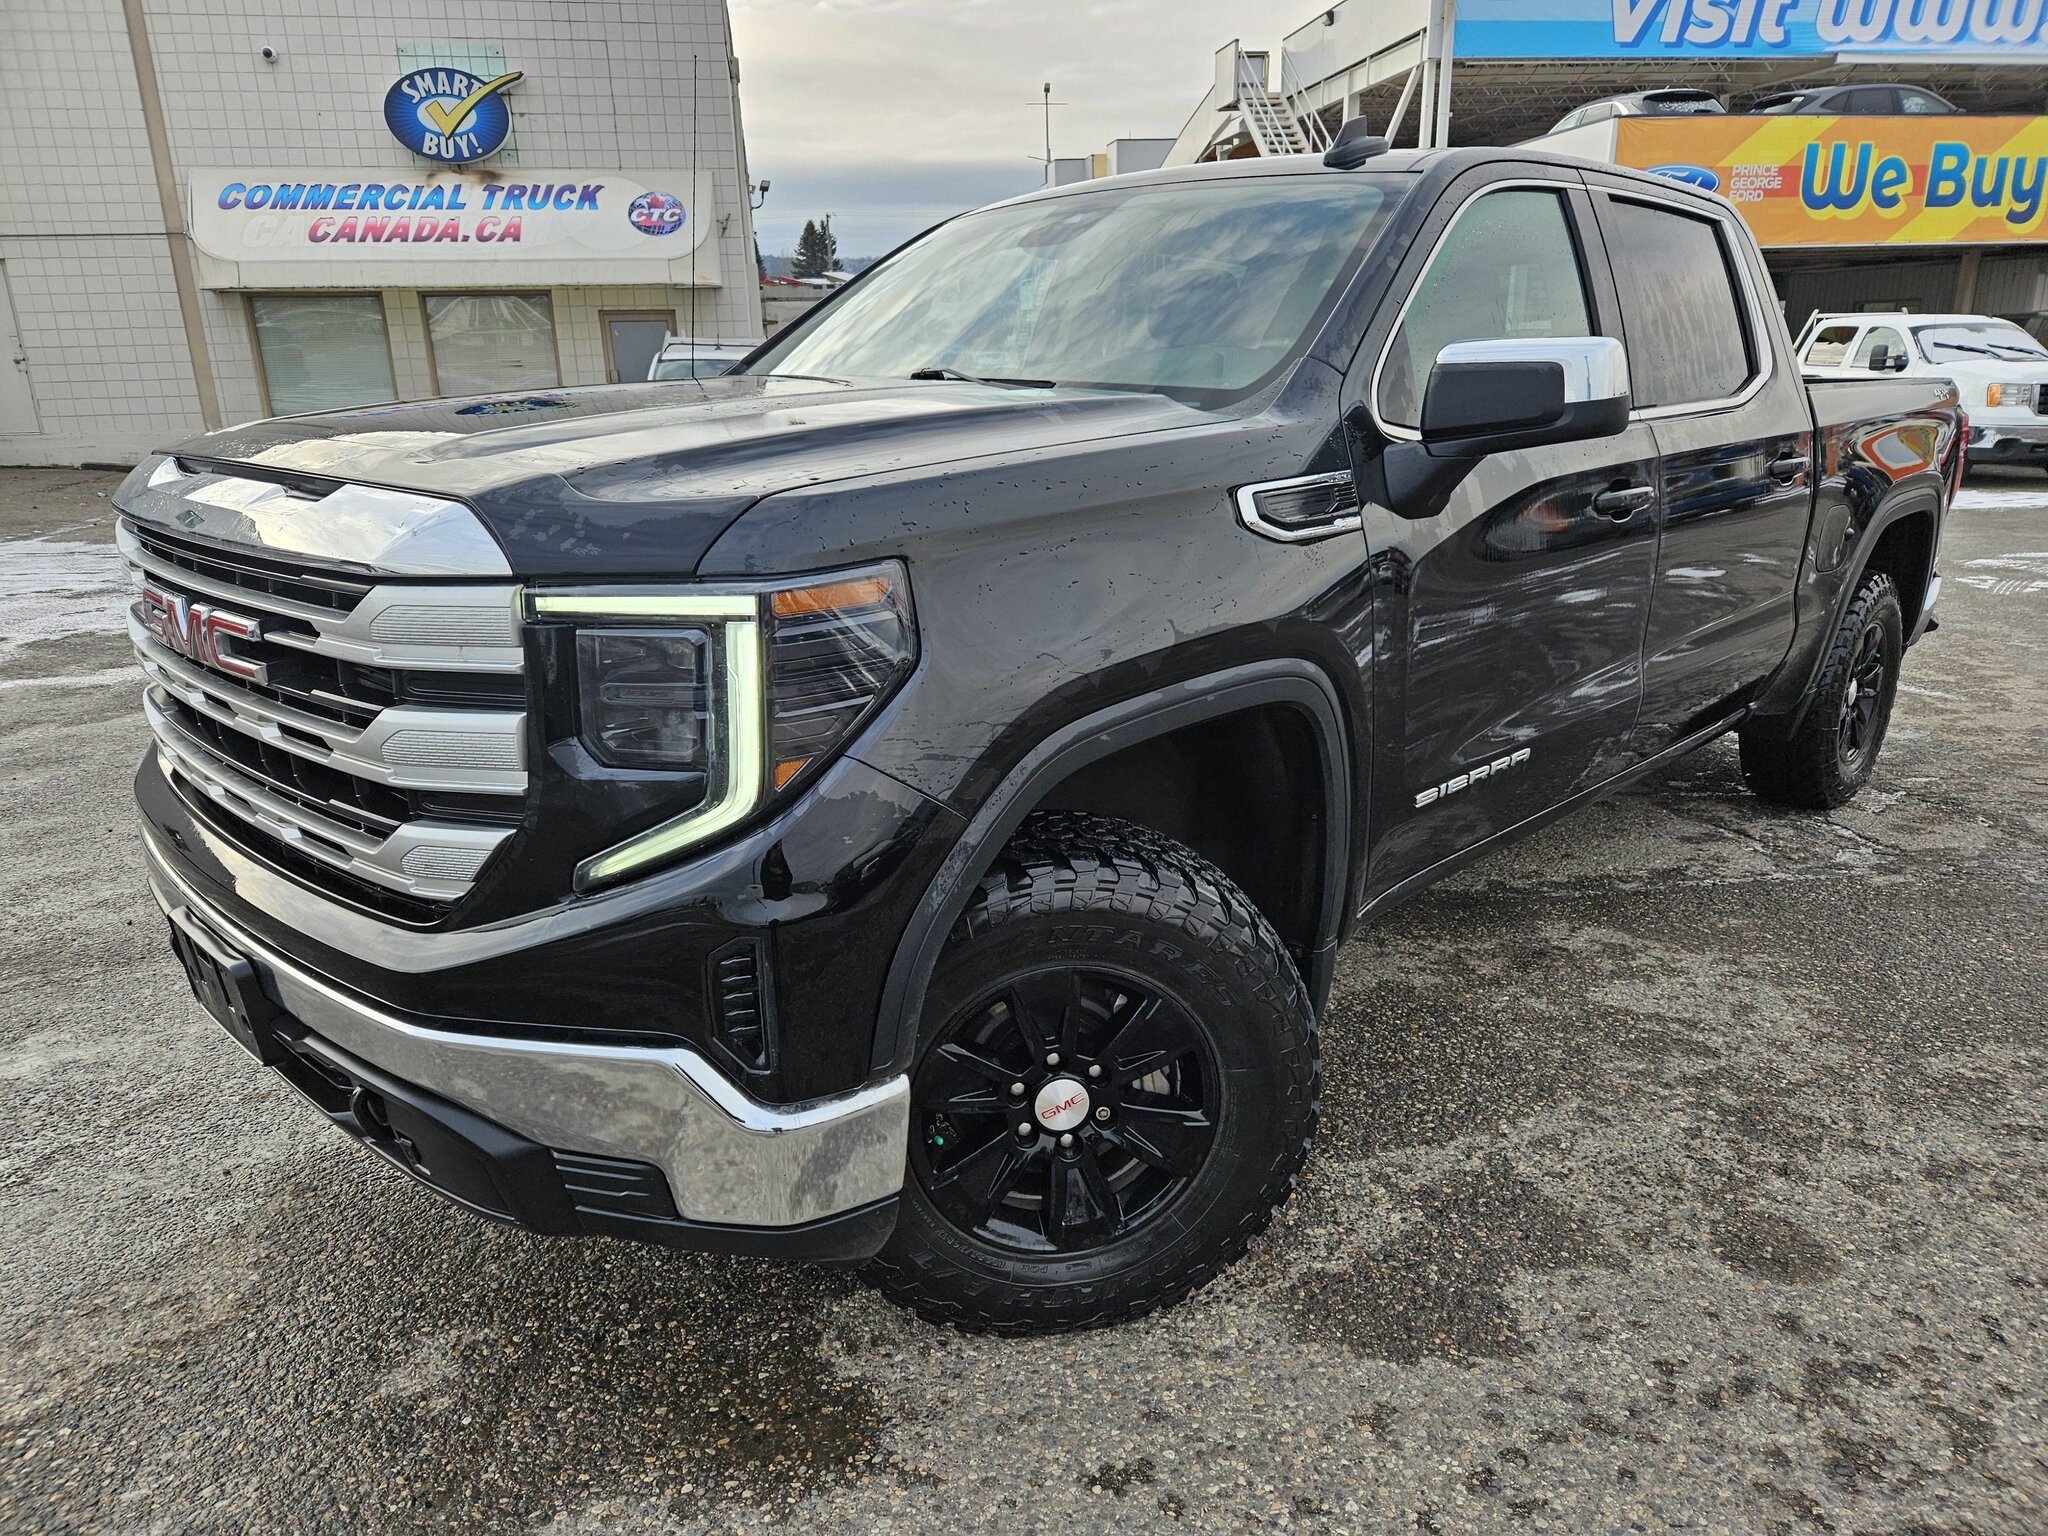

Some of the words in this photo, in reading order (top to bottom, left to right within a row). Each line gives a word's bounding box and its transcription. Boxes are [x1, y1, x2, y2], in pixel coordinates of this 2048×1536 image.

[401, 71, 484, 104] SMART
[422, 131, 483, 159] BUY!
[1730, 177, 1783, 189] GEORGE
[1732, 164, 1780, 176] PRINCE
[1801, 142, 1908, 211] We
[1924, 142, 2048, 225] Buy
[217, 182, 466, 210] COMMERCIAL
[482, 184, 605, 210] TRUCK
[1728, 190, 1764, 202] FORD
[308, 216, 522, 242] CANADA.CA
[630, 208, 682, 222] CTC
[142, 586, 269, 686] GMC
[1413, 747, 1532, 809] SIERRA
[1041, 1092, 1085, 1120] GMC
